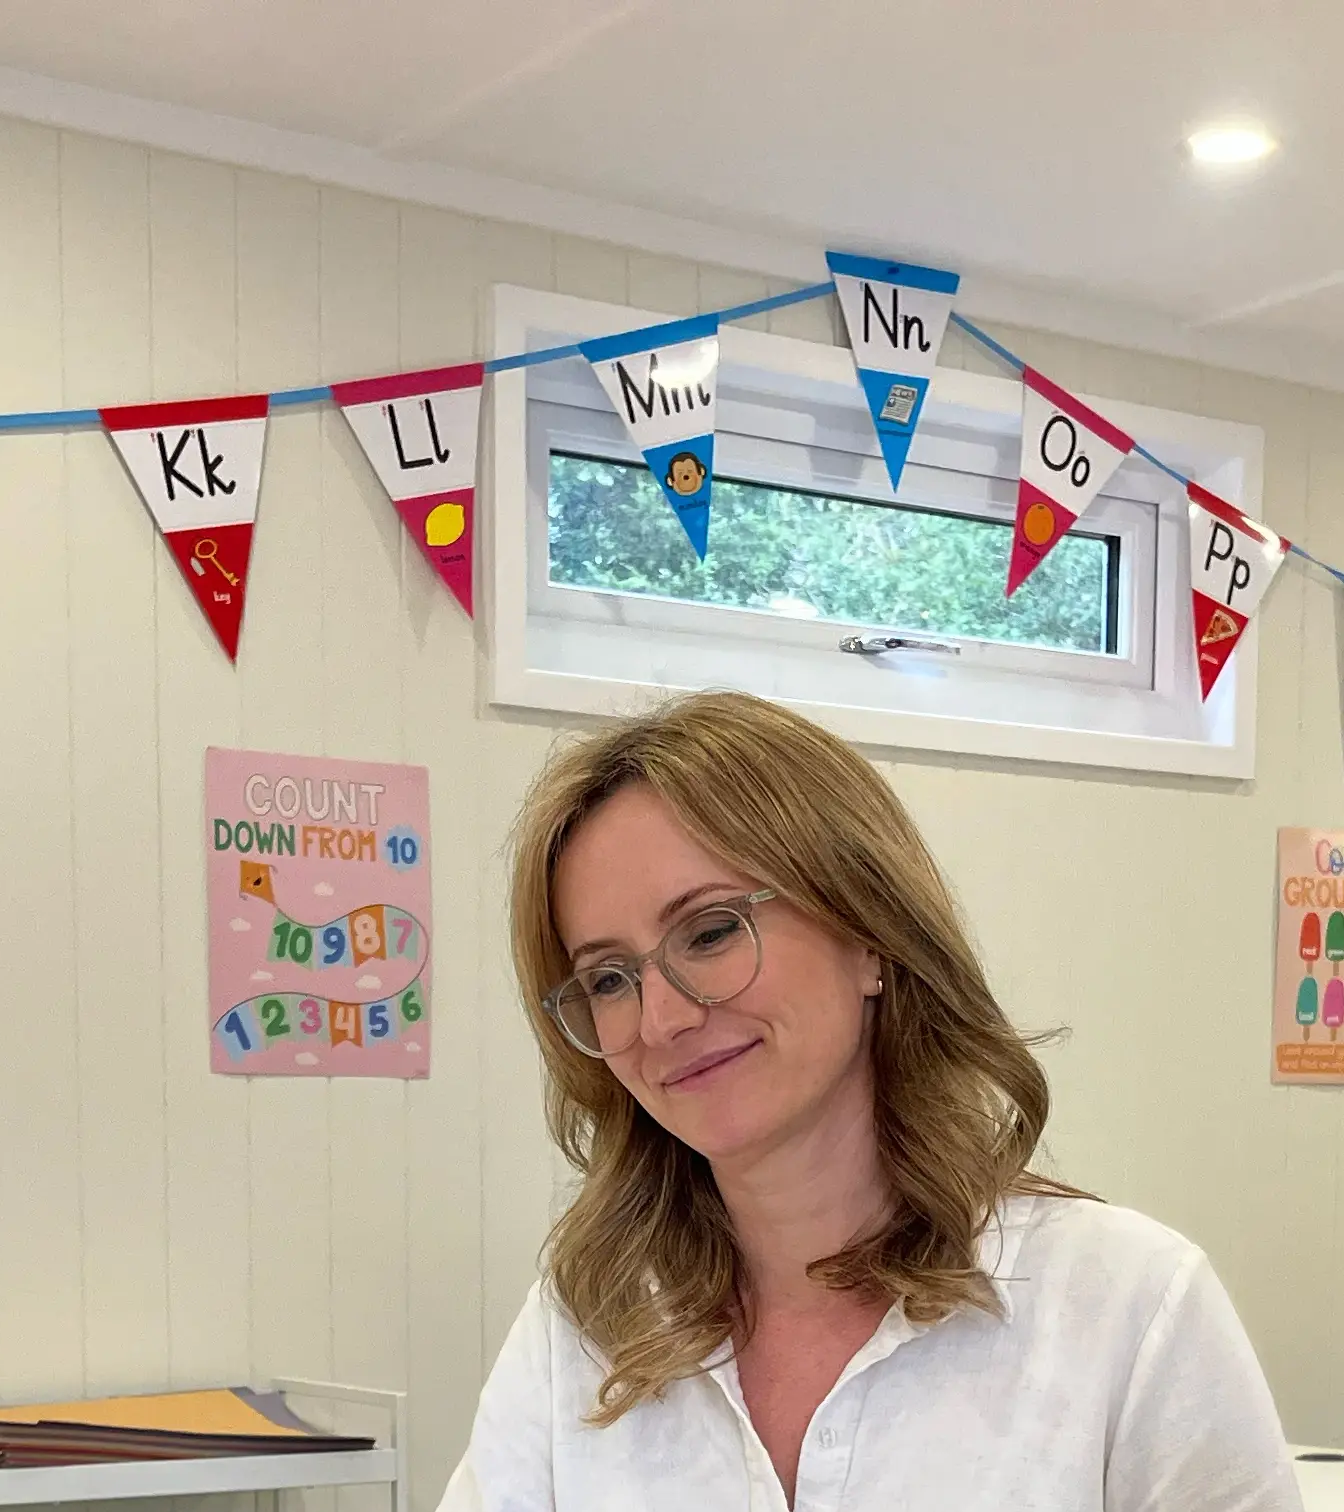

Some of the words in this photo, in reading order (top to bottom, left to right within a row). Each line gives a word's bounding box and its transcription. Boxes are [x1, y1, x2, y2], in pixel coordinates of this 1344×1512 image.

[863, 283, 930, 352] Nn
[156, 428, 237, 501] Kk
[388, 398, 450, 470] Ll
[1040, 415, 1091, 488] Oo
[1204, 521, 1251, 605] Pp
[244, 773, 386, 826] COUNT
[213, 818, 296, 857] DOWN
[301, 825, 377, 862] FROM
[387, 835, 417, 865] 10
[272, 921, 313, 964] 10
[323, 926, 346, 965] 9
[354, 913, 382, 955] 8
[391, 918, 413, 955] 7
[224, 1010, 252, 1052] 1
[261, 999, 290, 1037] 2
[298, 1000, 322, 1035] 3
[334, 1004, 355, 1040] 4
[368, 1004, 390, 1038] 5
[401, 990, 421, 1022] 6
